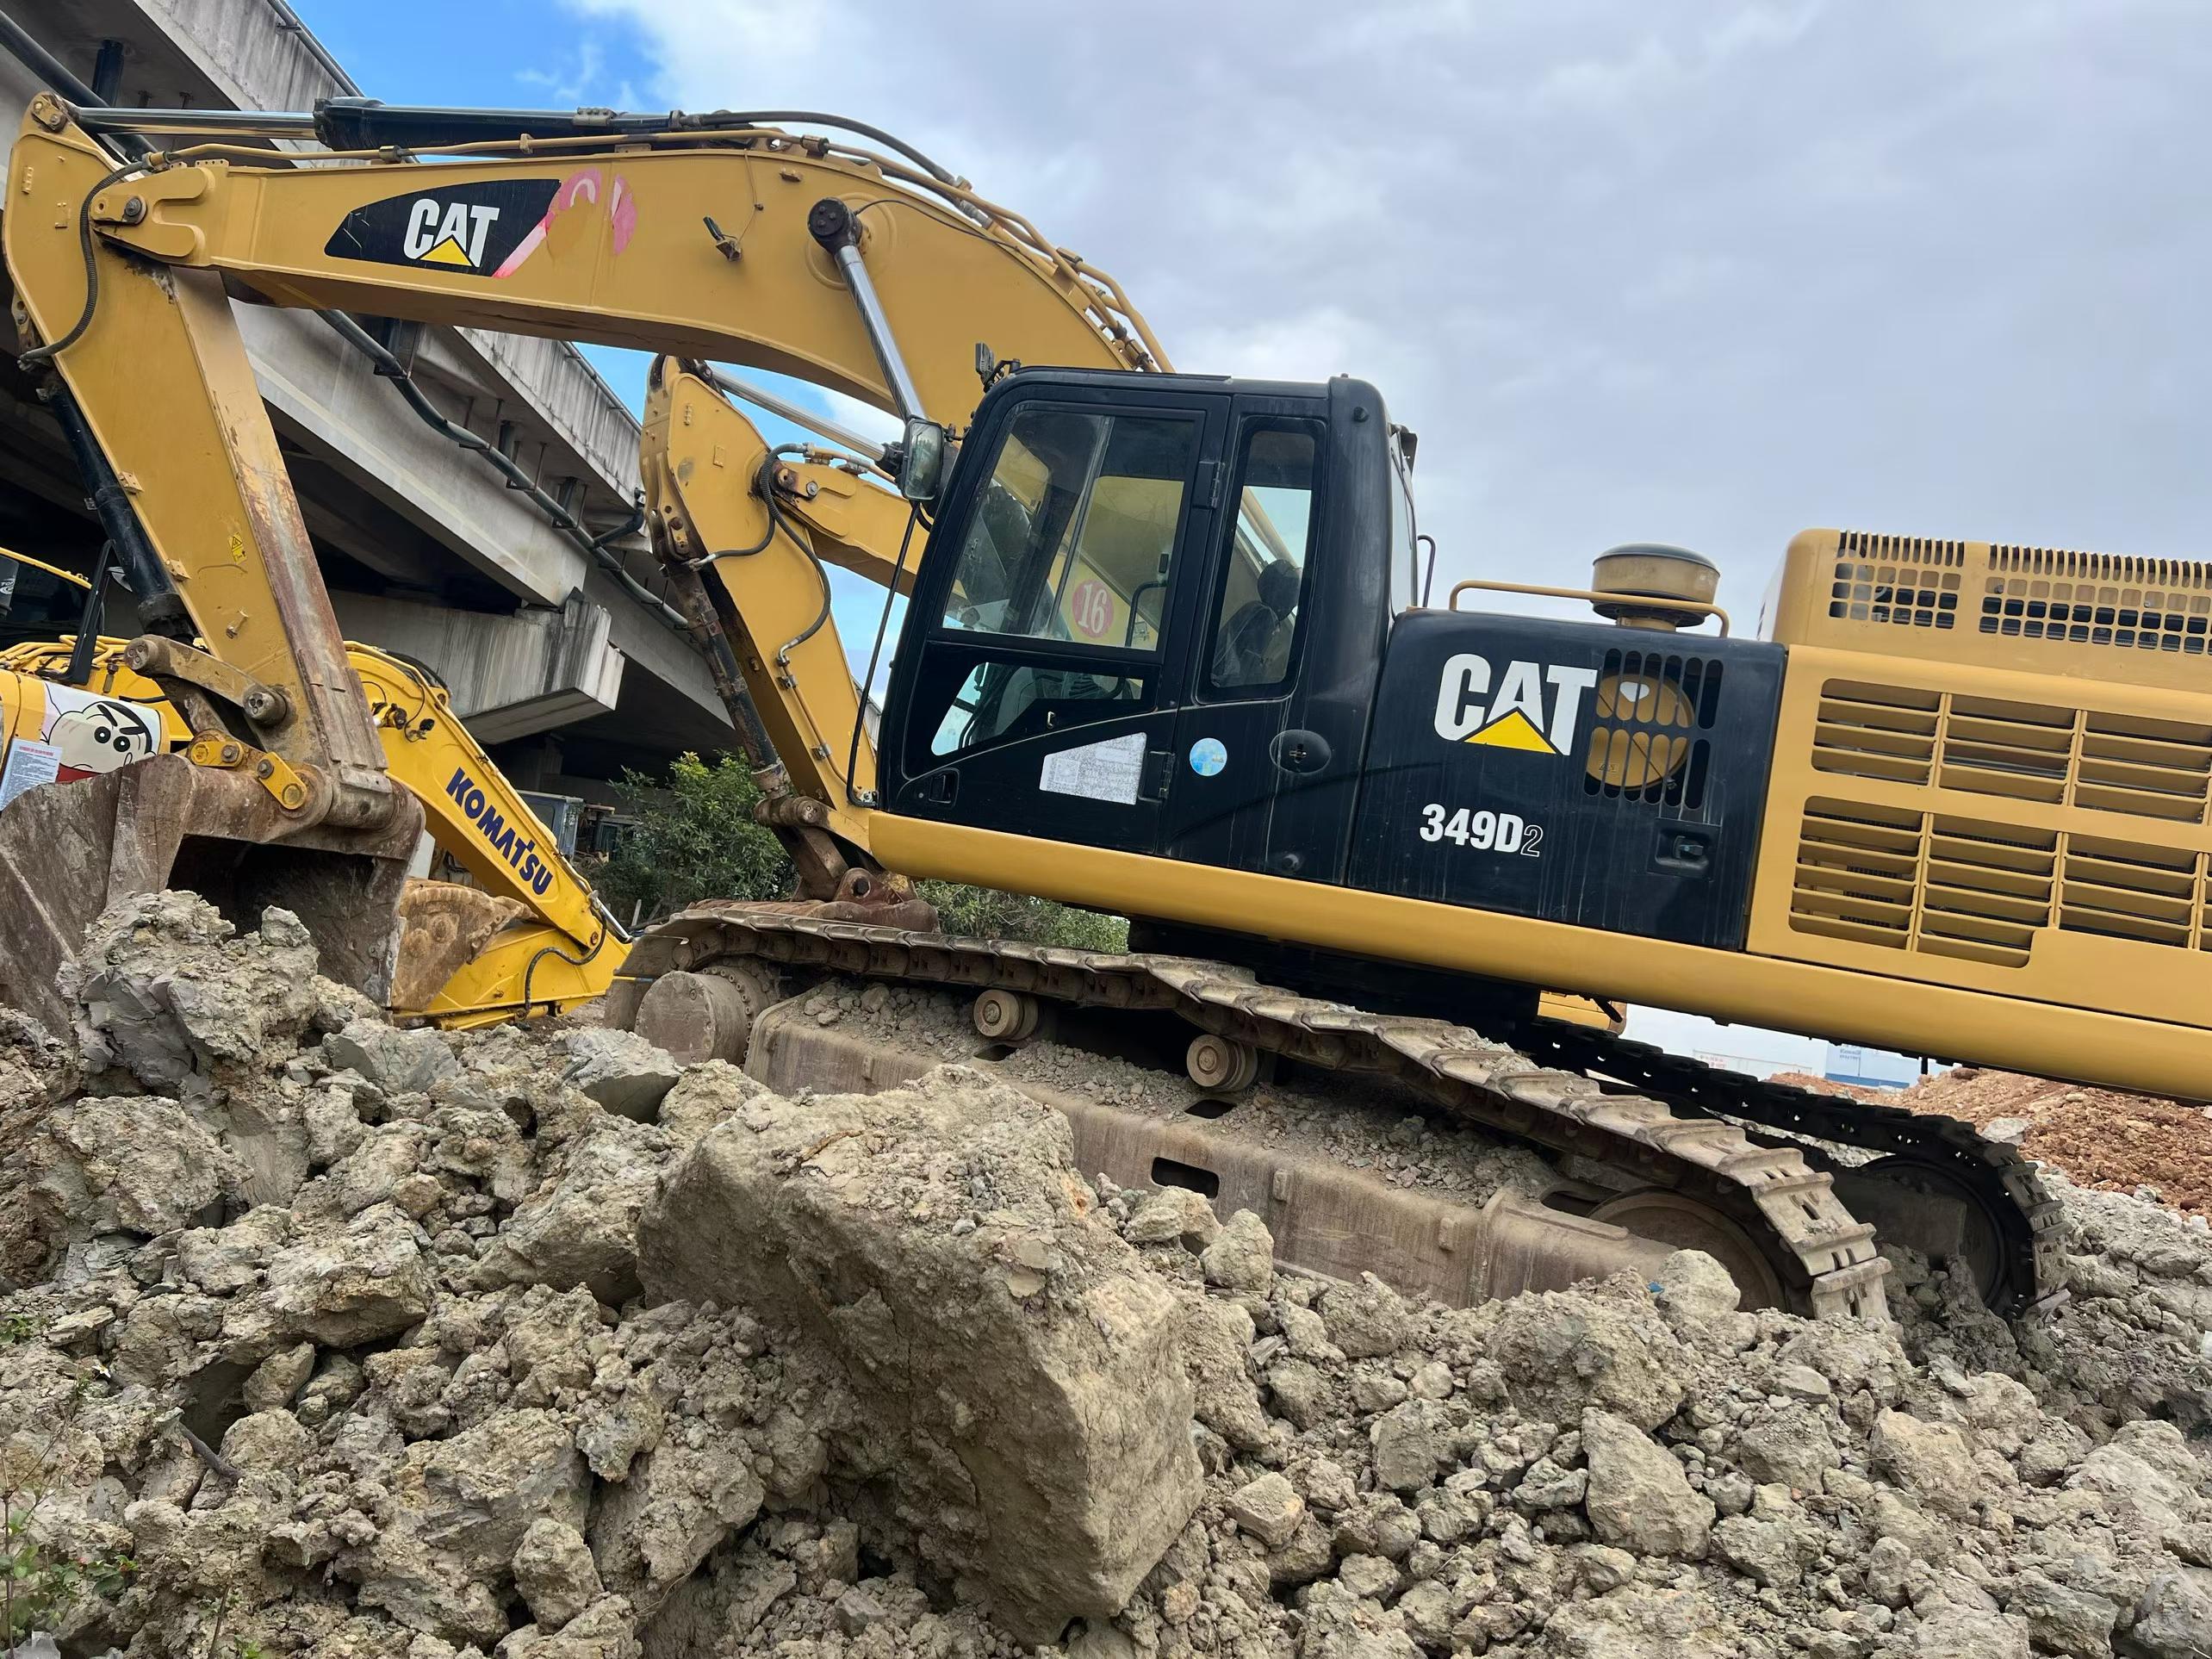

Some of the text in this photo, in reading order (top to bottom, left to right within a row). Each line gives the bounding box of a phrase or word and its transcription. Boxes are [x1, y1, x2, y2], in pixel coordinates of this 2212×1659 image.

[404, 199, 500, 268] CAT
[1078, 584, 1107, 633] 16
[1434, 653, 1598, 755] CAT
[446, 767, 553, 895] KOMATSU
[1420, 803, 1544, 857] 349D2
